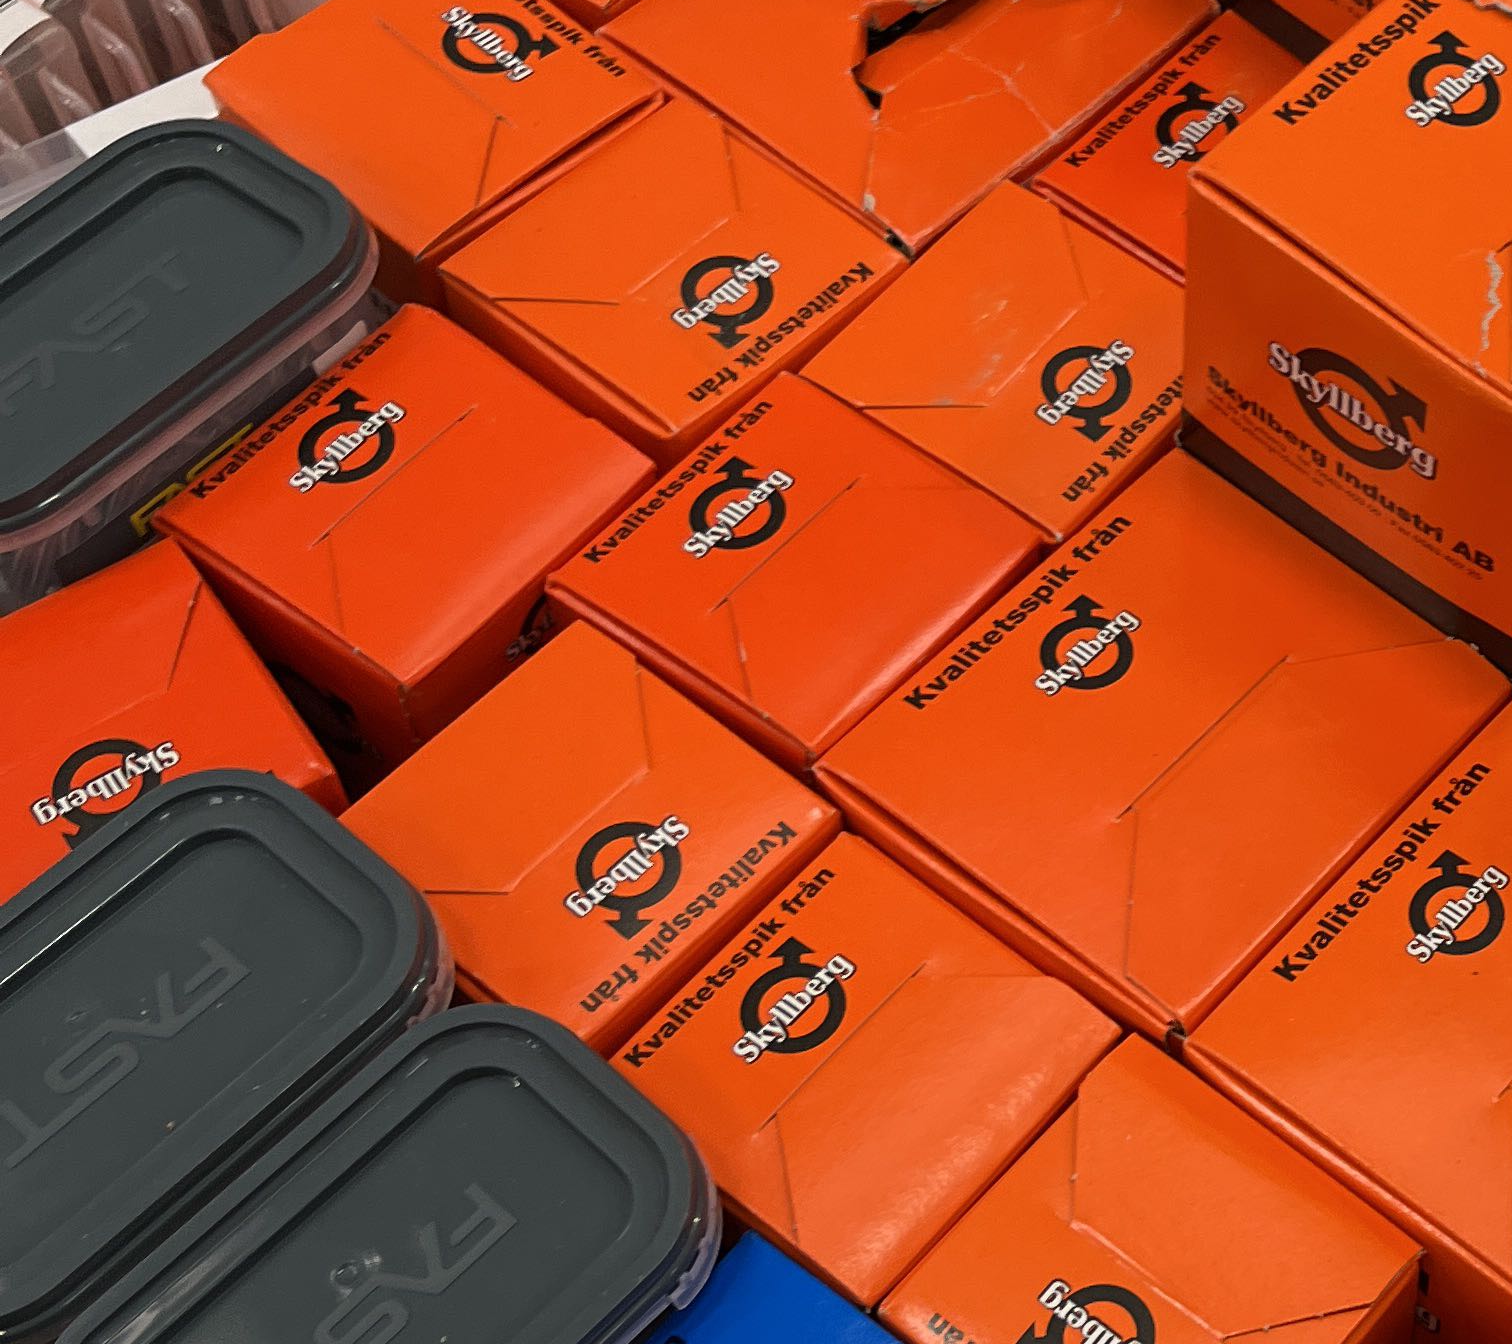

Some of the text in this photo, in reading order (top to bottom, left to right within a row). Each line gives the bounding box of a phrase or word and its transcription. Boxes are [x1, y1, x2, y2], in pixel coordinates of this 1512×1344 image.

[441, 5, 534, 82] Skyllberg
[582, 35, 626, 78] från
[1405, 52, 1505, 128] Skyllberg
[1063, 33, 1223, 168] Kvalitetsspik från
[671, 252, 780, 329] Skyllberg
[686, 261, 873, 403] Kvalitetsspik från
[191, 374, 342, 500] Kvalitetsspik
[342, 331, 392, 371] från
[1036, 339, 1134, 426] Skyllberg
[1268, 341, 1438, 480] Skyllberg
[288, 401, 405, 492] Skyllberg
[585, 398, 773, 564] Kvalitetsspik från
[1061, 461, 1110, 502] från
[1206, 365, 1330, 472] Skyllberg
[1337, 461, 1444, 545] Industri
[1450, 537, 1496, 573] AB
[683, 469, 794, 559] Skyllberg
[903, 514, 1133, 711] Kvalitetsspik från
[1035, 609, 1140, 696] Skyllberg
[30, 742, 179, 826] Skyllberg
[563, 814, 690, 918] Skyllberg
[580, 820, 798, 1013] Kvalitetsspik från
[1272, 761, 1492, 983] Kvalitetsspik från
[1406, 866, 1508, 962] Skyllberg
[625, 867, 835, 1069] Kvalitetsspik från
[732, 954, 856, 1063] Skyllberg
[0, 936, 251, 1169] FAST
